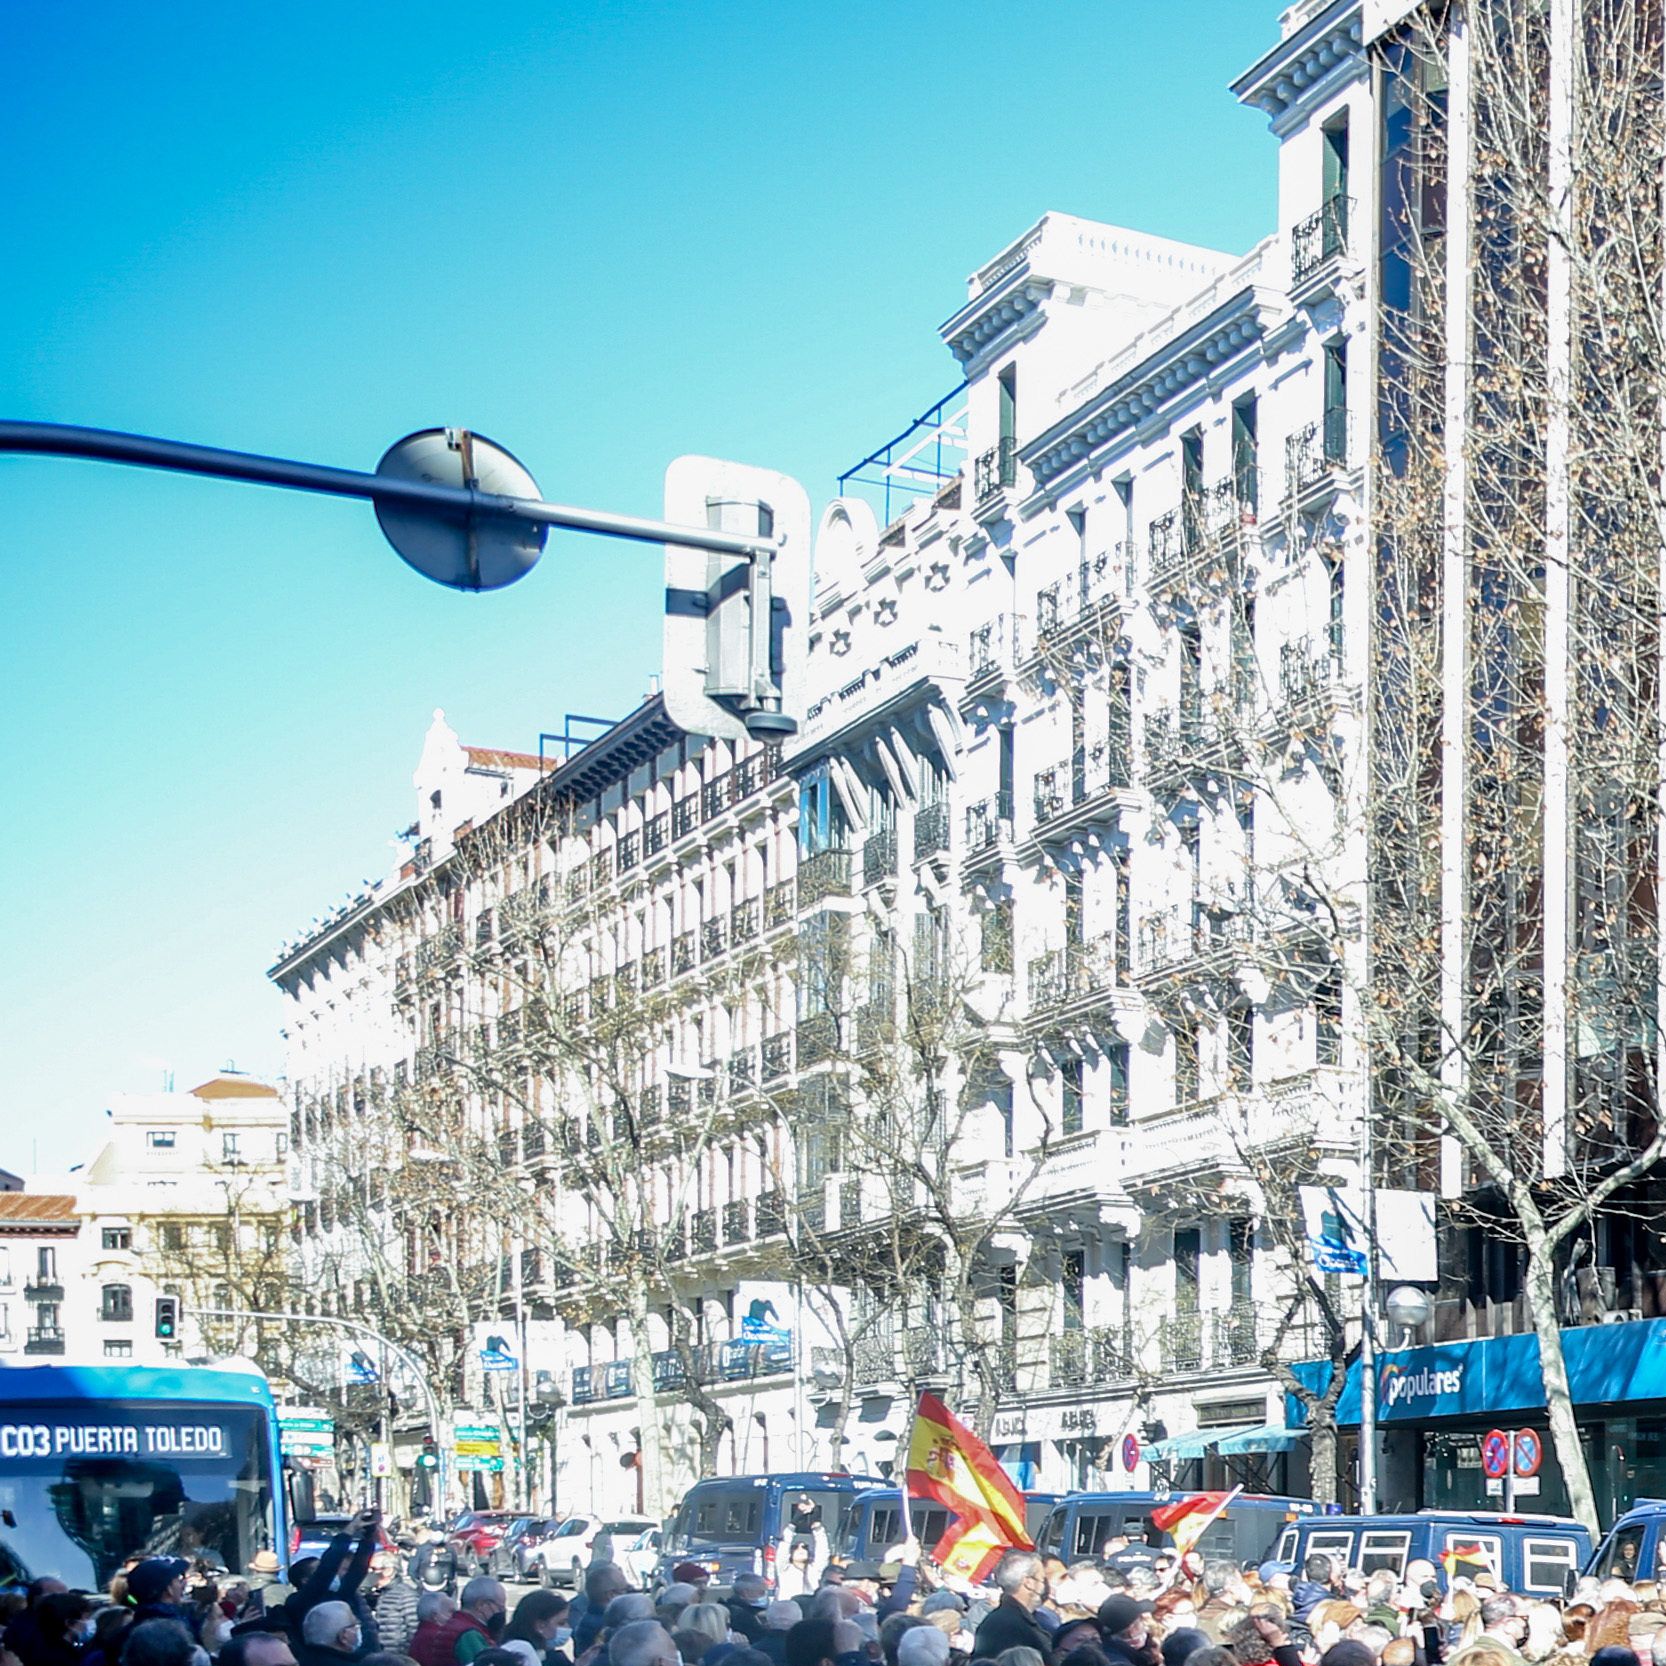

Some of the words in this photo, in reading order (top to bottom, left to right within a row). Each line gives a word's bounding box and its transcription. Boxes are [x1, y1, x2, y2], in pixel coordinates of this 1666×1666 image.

[1388, 1366, 1461, 1407] populares
[54, 1426, 139, 1453] PUERTA
[145, 1426, 223, 1452] TOLEDO
